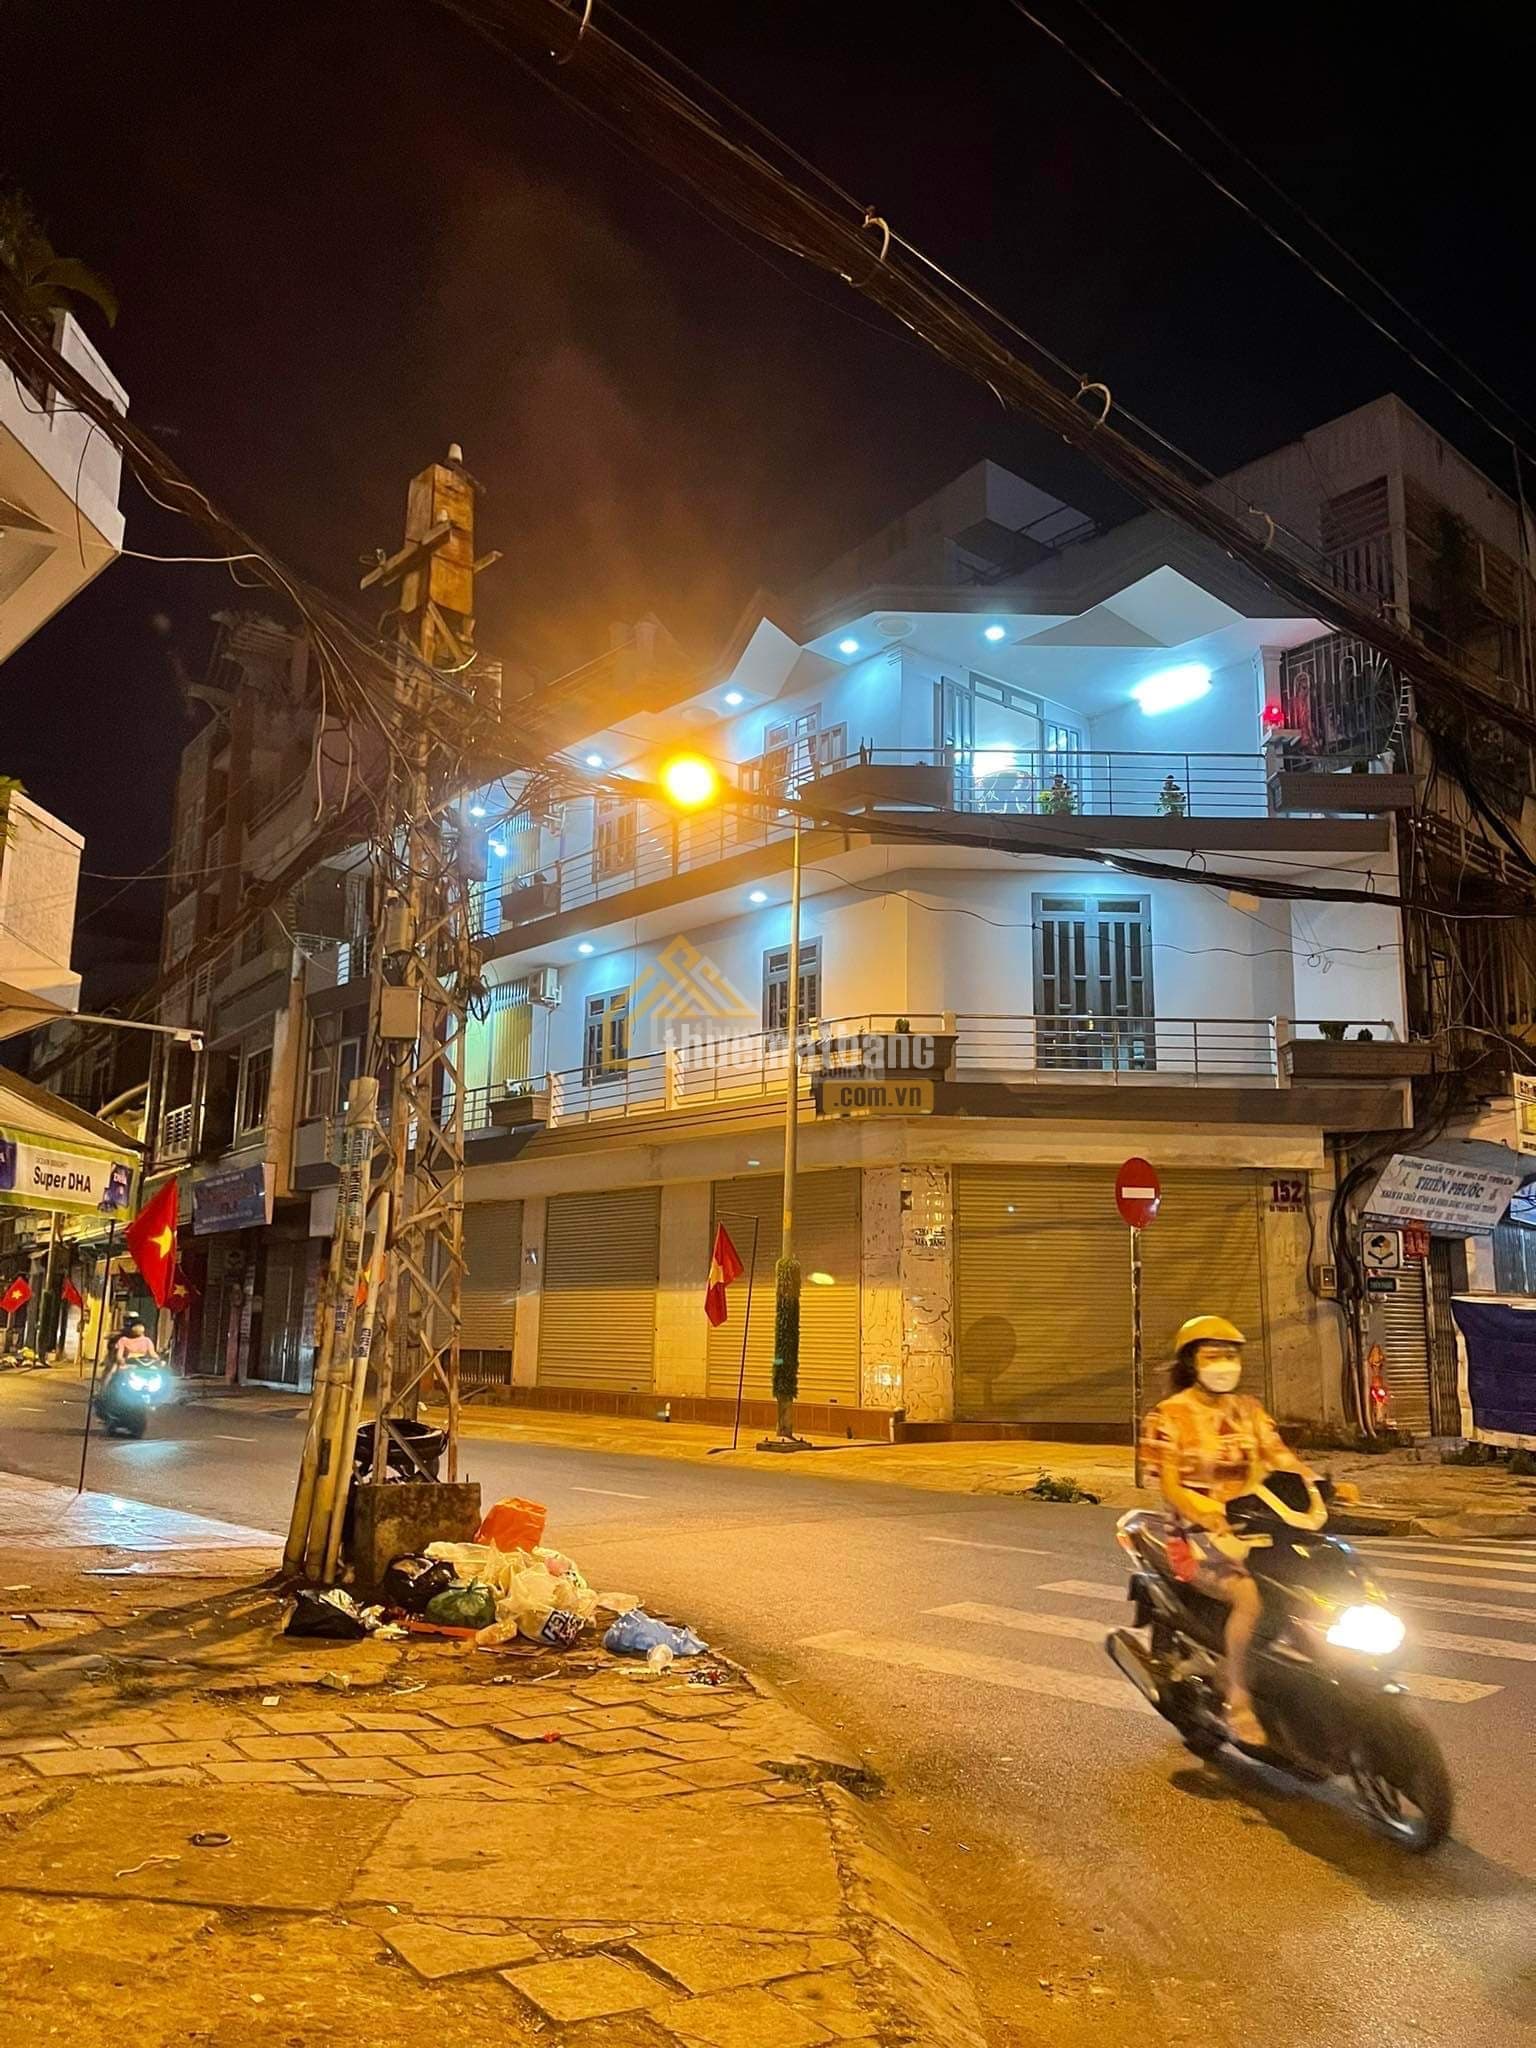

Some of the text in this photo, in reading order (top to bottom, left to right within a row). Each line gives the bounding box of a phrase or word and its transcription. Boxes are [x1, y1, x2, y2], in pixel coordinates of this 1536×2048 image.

[33, 1166, 91, 1193] Super DHA
[1270, 1180, 1303, 1202] 152
